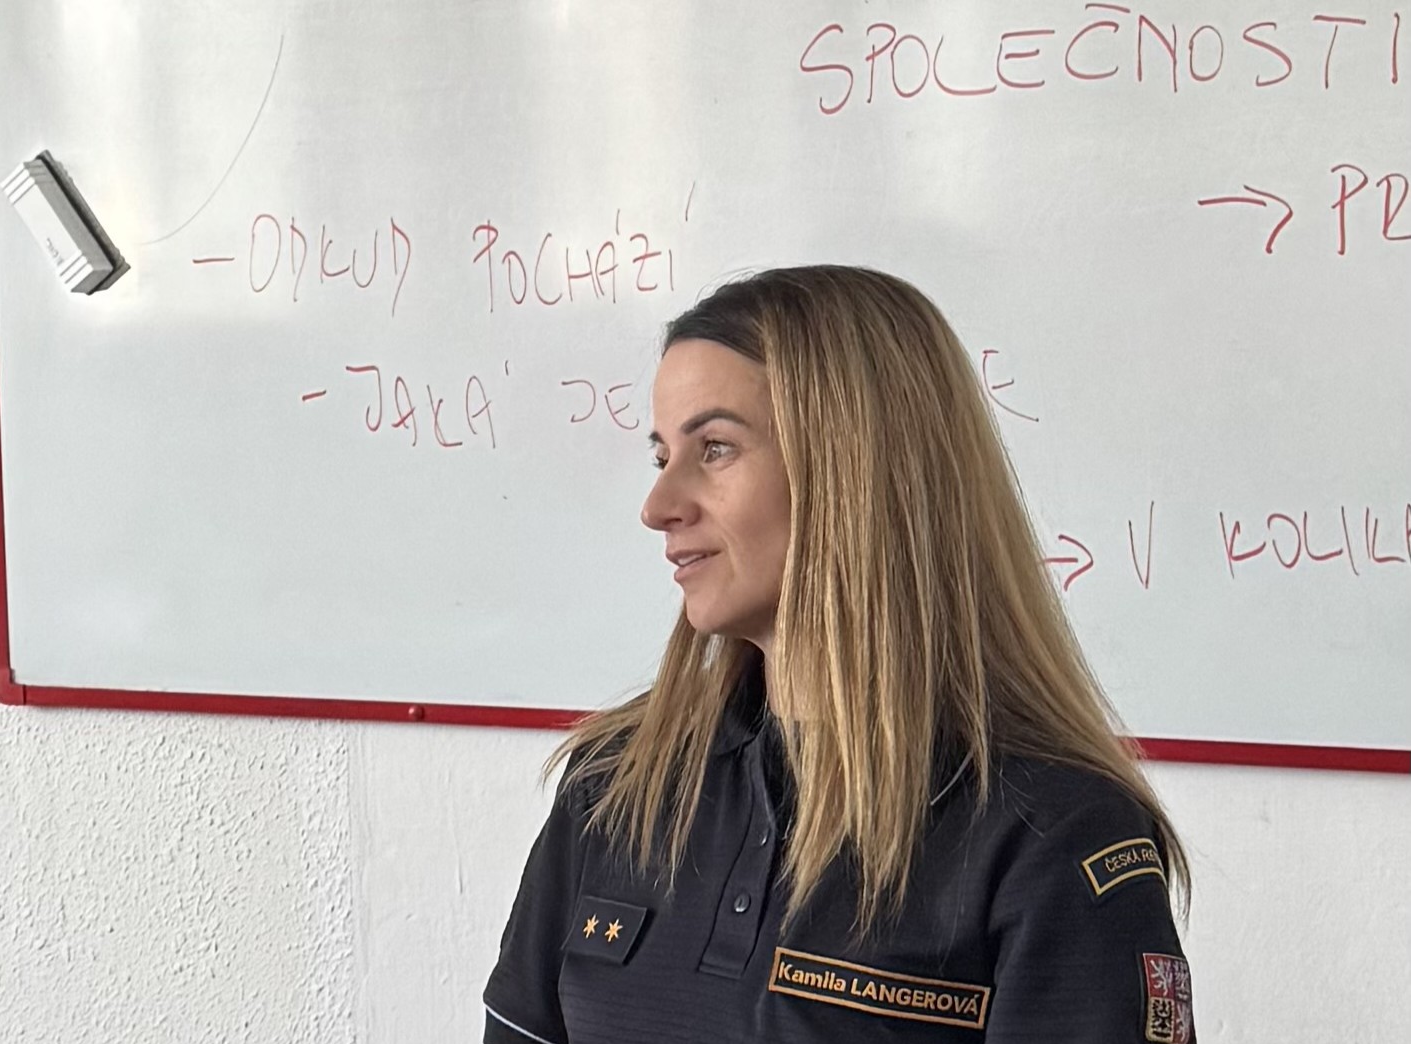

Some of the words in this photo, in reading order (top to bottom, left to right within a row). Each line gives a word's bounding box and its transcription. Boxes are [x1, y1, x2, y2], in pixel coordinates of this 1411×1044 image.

[1127, 499, 1156, 590] V
[778, 960, 847, 993] Kamila
[850, 977, 980, 1016] LANGEROVÁ
